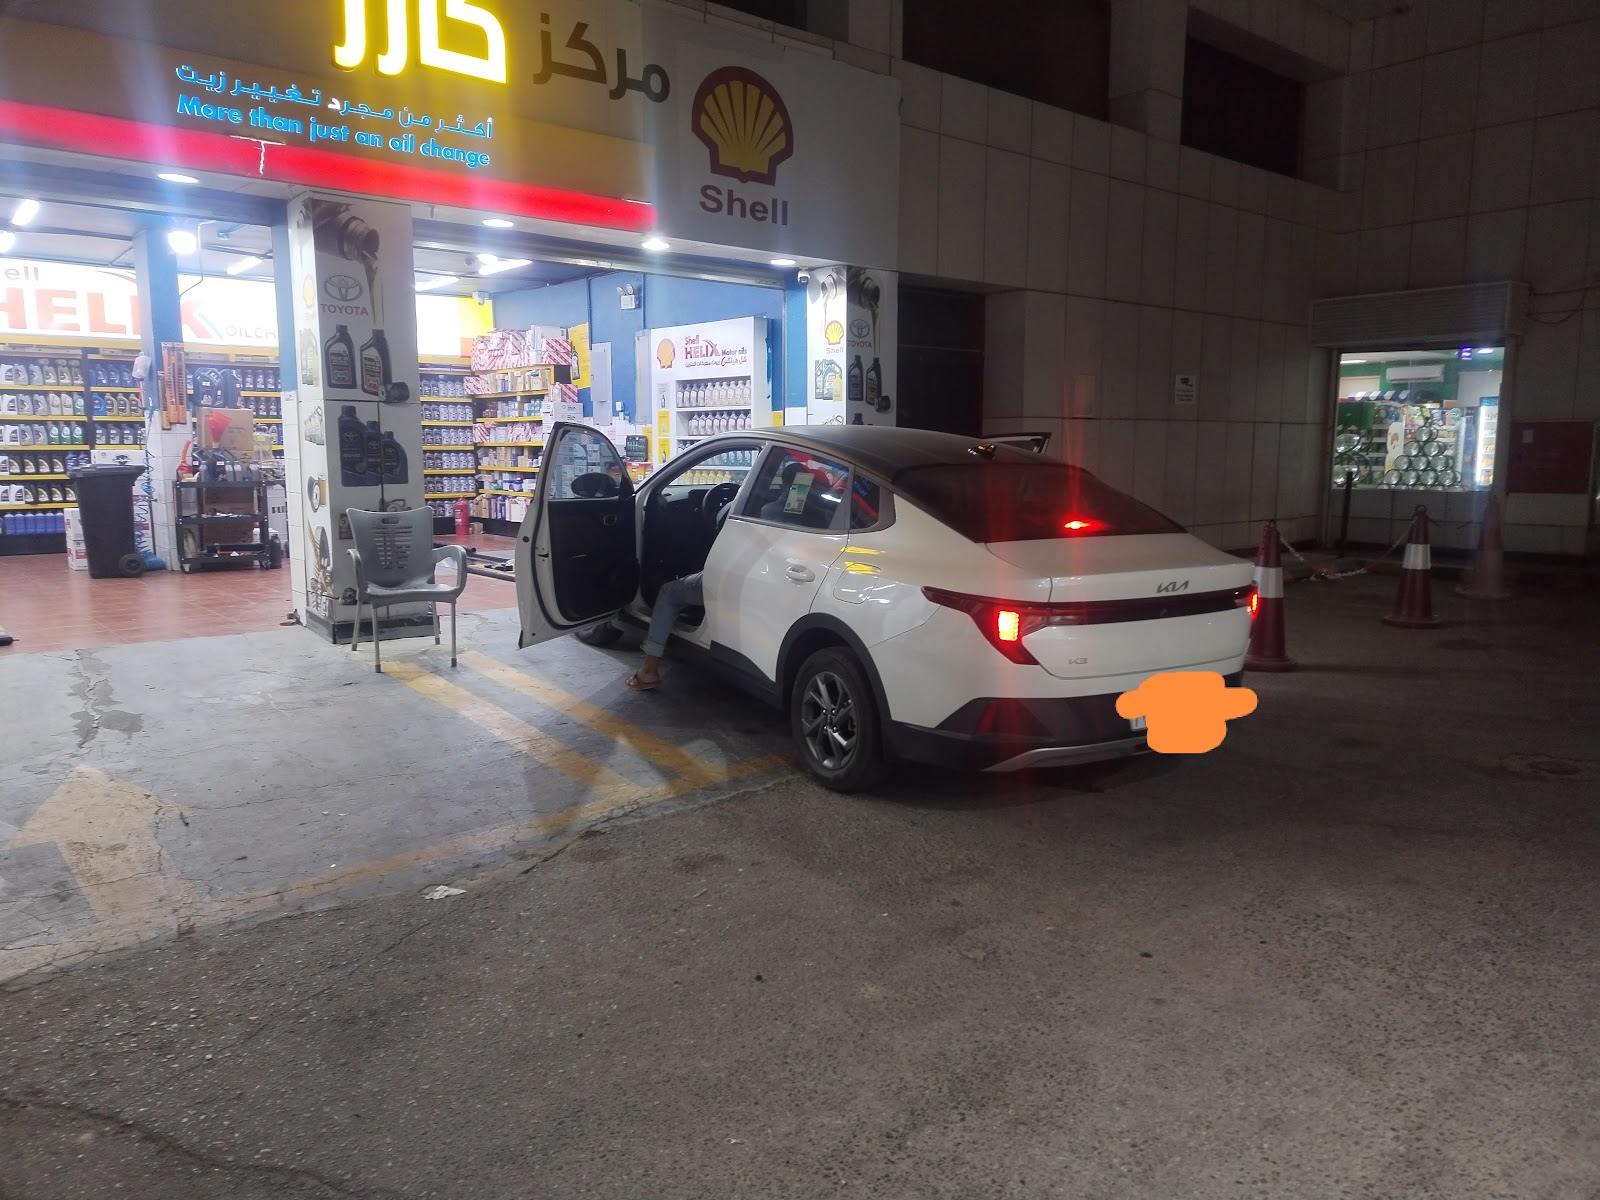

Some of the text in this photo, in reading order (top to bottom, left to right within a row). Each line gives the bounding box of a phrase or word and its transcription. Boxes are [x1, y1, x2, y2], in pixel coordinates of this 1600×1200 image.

[533, 12, 670, 103] مركز
[175, 65, 493, 138] أكثر من مجرد تغيير زيت
[177, 94, 491, 168] More than just an oil change
[698, 183, 789, 227] Shell
[320, 303, 369, 317] TOYOTA
[685, 334, 700, 345] Shell
[848, 339, 872, 349] TOYOTA
[685, 341, 720, 359] HELIX
[1156, 580, 1190, 594] KIA
